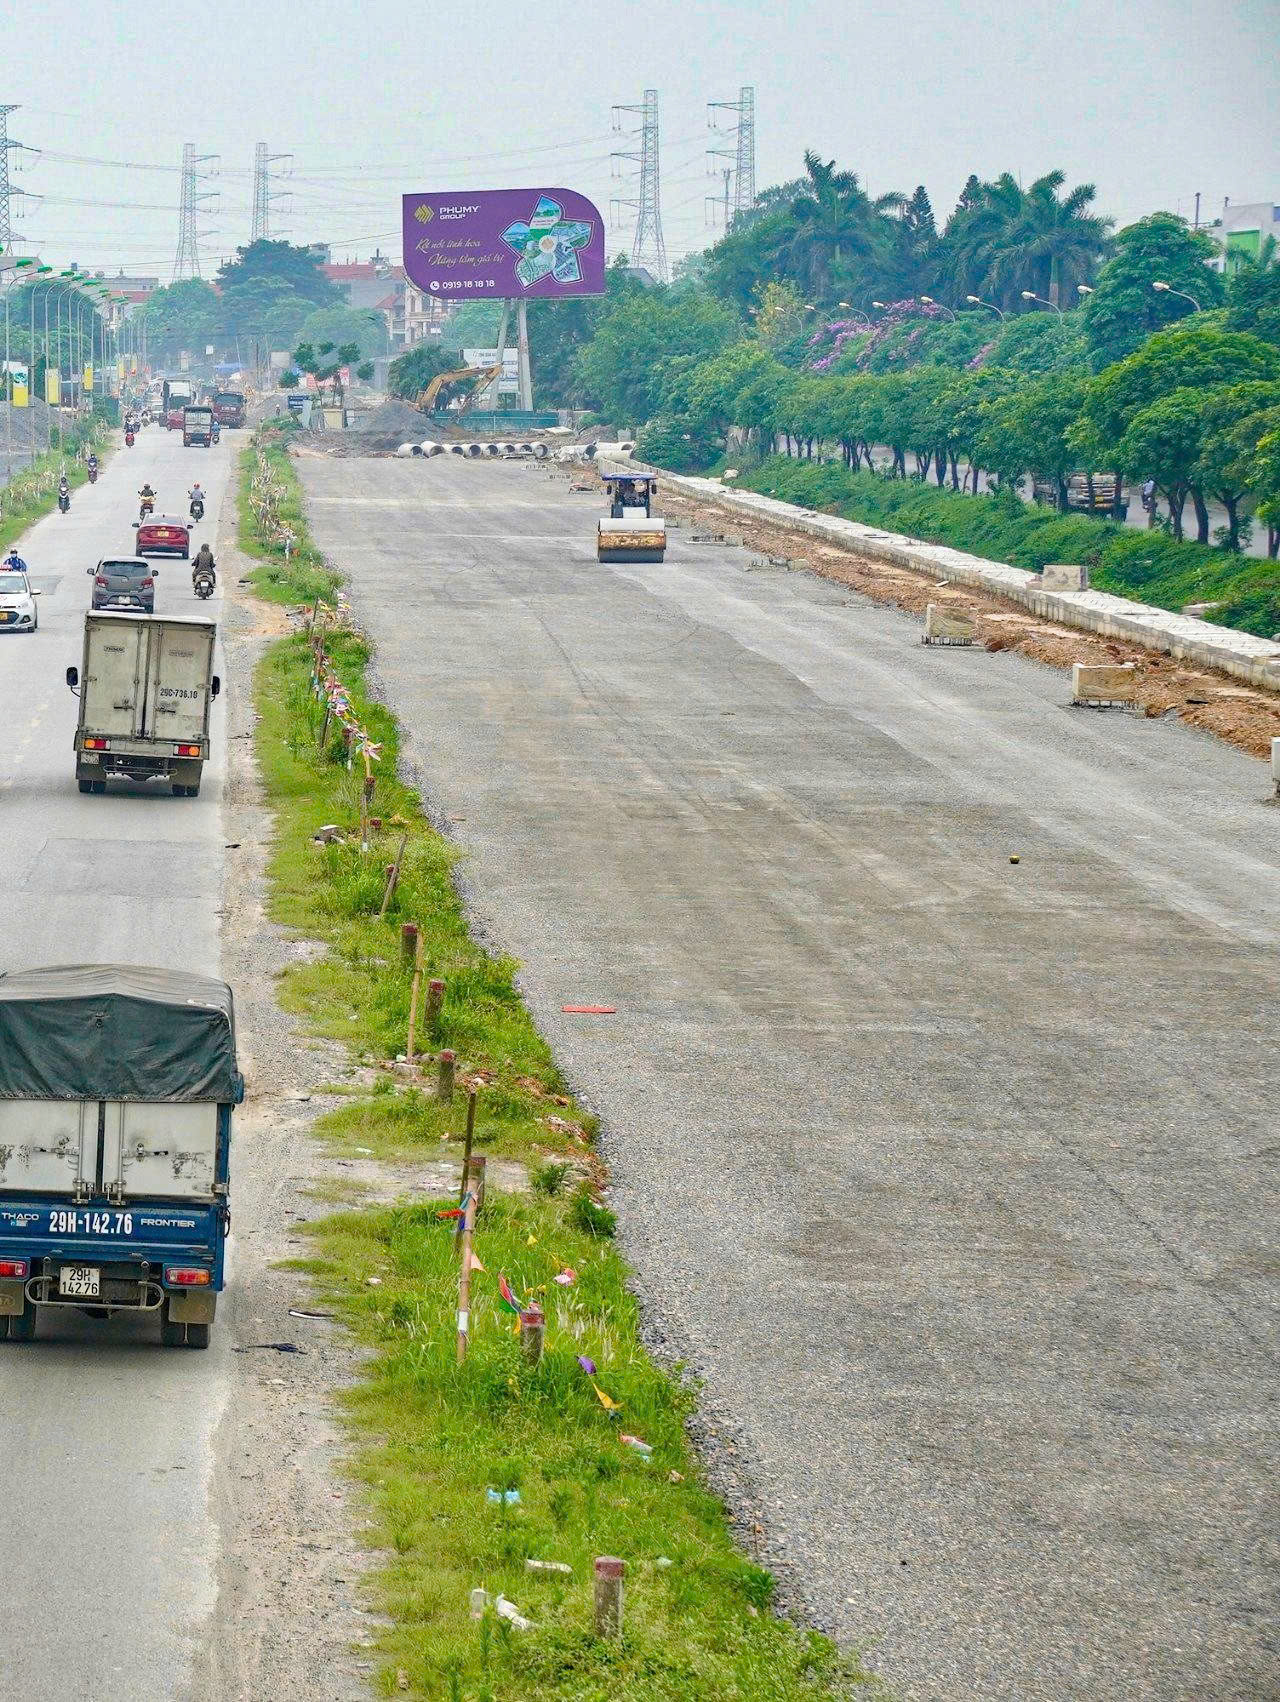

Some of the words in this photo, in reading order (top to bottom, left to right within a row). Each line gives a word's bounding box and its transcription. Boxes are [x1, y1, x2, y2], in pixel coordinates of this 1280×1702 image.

[439, 205, 480, 214] PHUMY
[442, 281, 462, 289] 0919
[463, 280, 473, 288] 18
[474, 279, 484, 287] 18
[485, 279, 495, 287] 18
[1, 1212, 40, 1221] THACO
[49, 1211, 133, 1235] 29H-142.76
[141, 1218, 196, 1228] FRONTIER
[69, 1268, 91, 1281] 29H
[62, 1281, 98, 1294] 142.76
